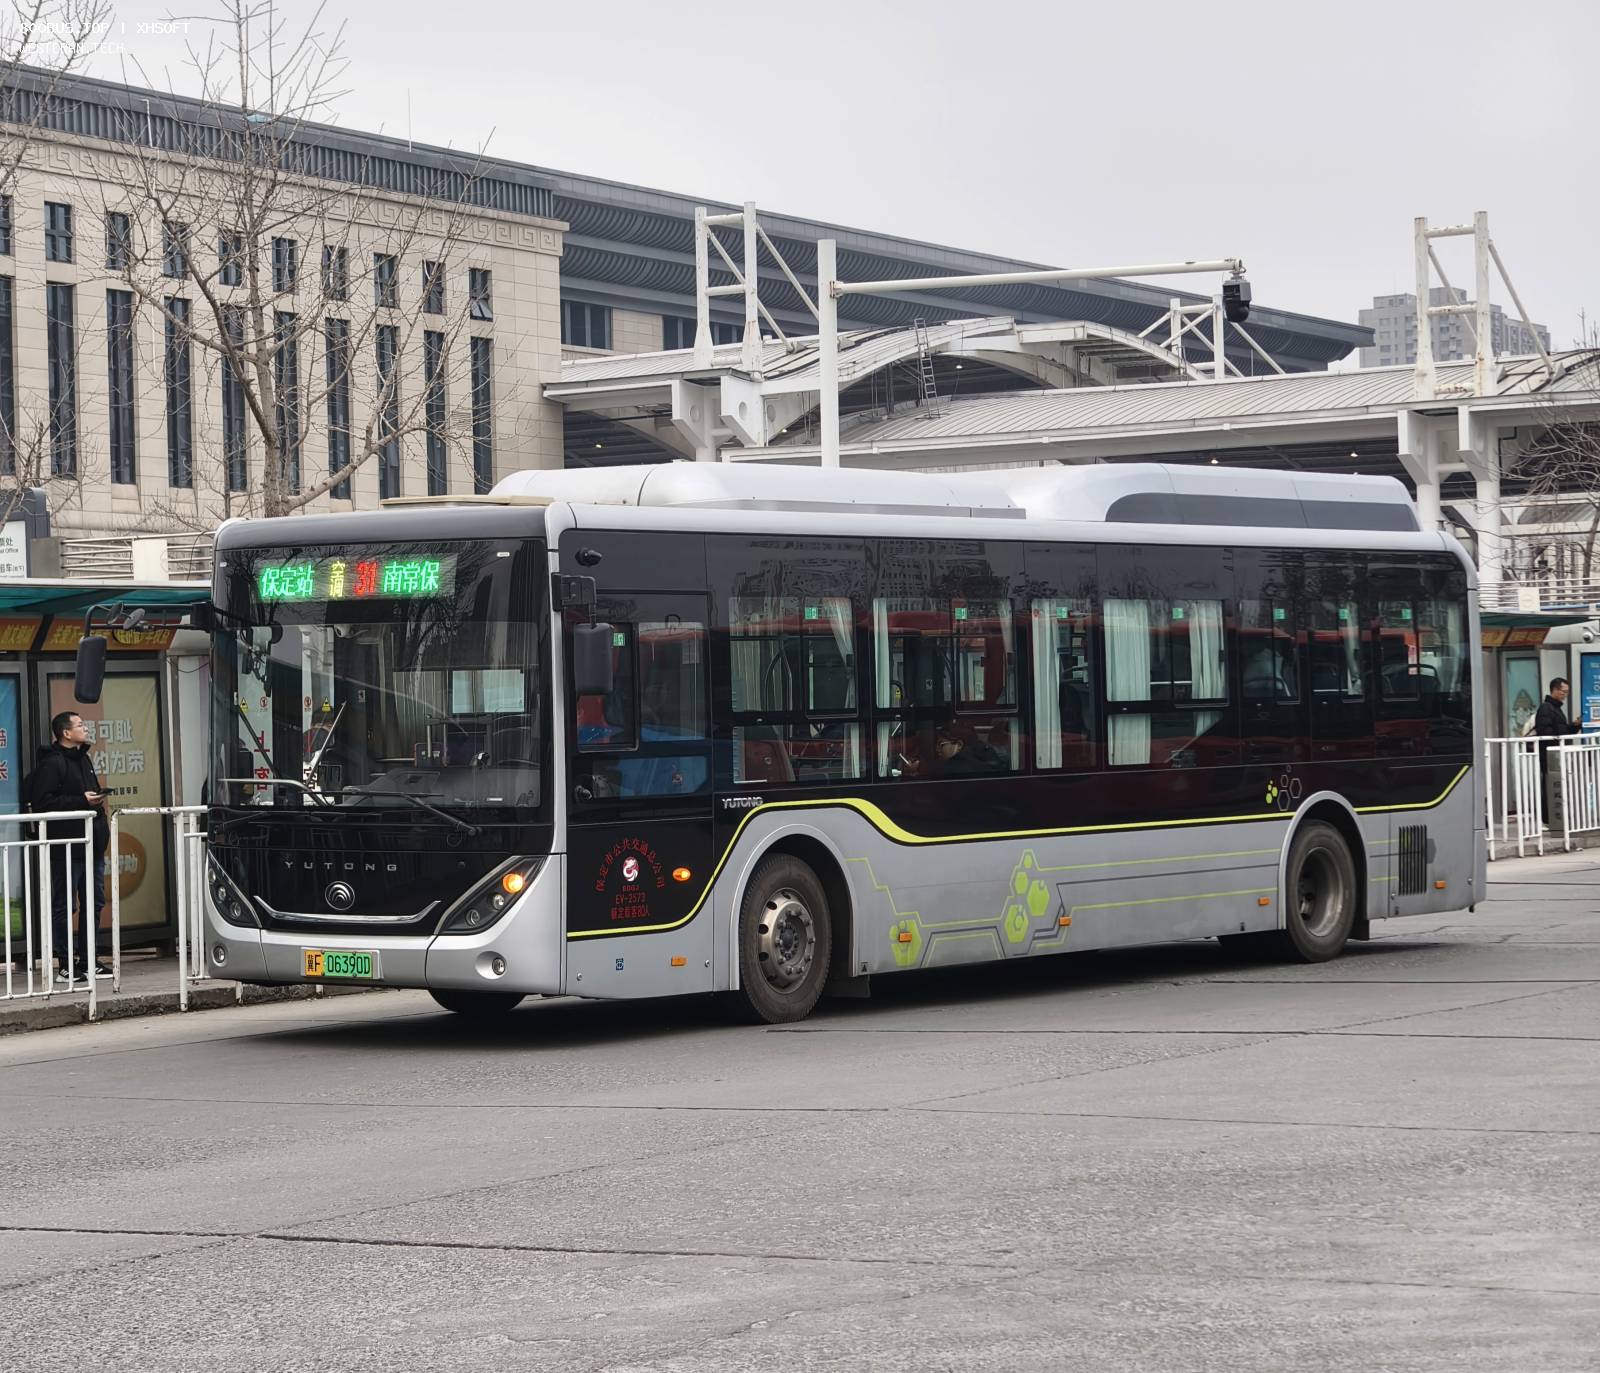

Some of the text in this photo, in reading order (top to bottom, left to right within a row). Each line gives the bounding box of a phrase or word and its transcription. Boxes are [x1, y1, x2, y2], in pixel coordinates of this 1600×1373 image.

[261, 564, 314, 597] 保定站
[383, 560, 440, 593] 南常保
[87, 751, 144, 775] 约为荣
[721, 796, 764, 809] YUTONG
[284, 860, 398, 872] YUTONG
